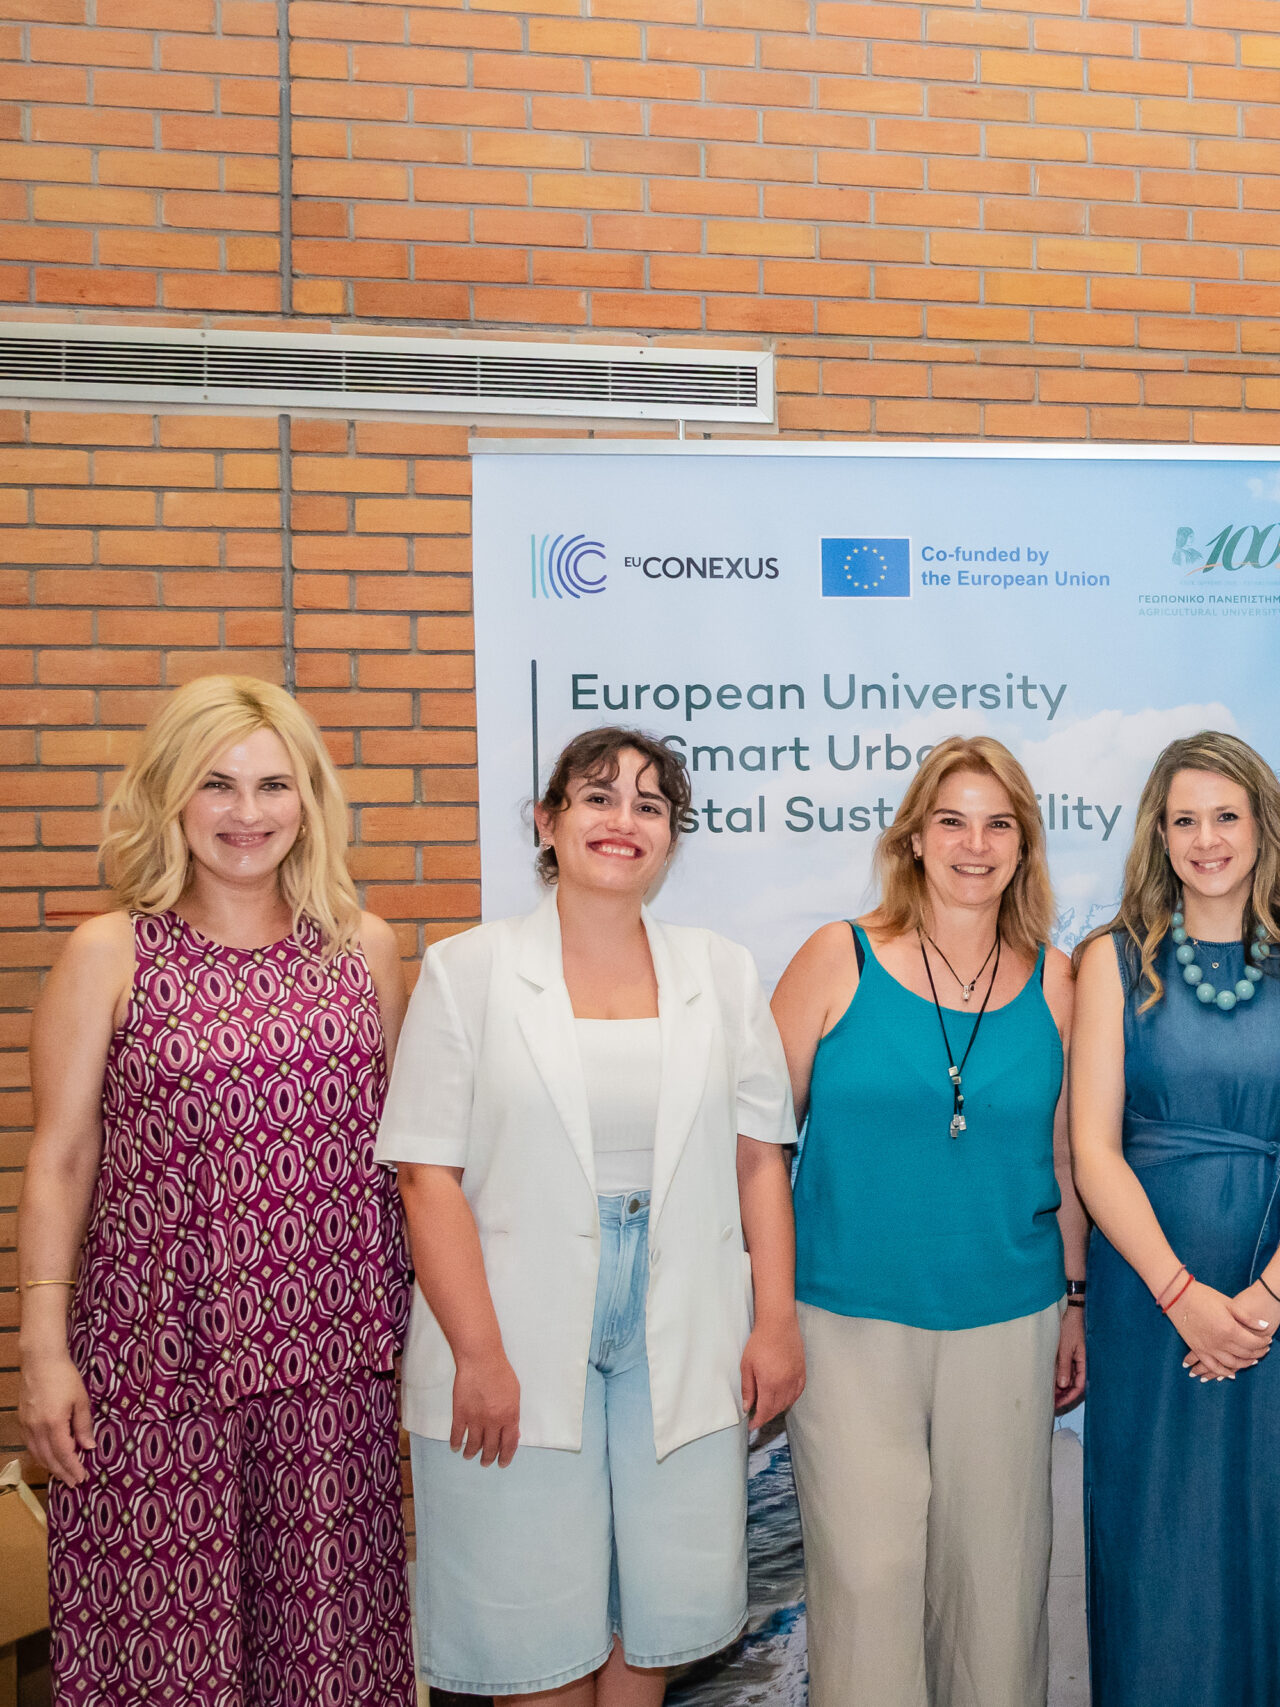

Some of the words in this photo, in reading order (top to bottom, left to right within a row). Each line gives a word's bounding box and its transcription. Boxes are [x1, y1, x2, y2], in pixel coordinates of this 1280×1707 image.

[921, 546, 1020, 562] Co-funded
[1027, 546, 1050, 566] by
[921, 570, 951, 586] the
[957, 570, 1048, 589] European
[1055, 571, 1110, 586] Union
[1138, 595, 1205, 604] ΓΕΩΠΟΝΙΚΟ
[1138, 608, 1218, 617] AGRICULTURAL
[571, 673, 804, 721] European
[823, 672, 1067, 720] University
[659, 734, 810, 772] Smart
[828, 733, 934, 771] Urb
[680, 795, 765, 834] stal
